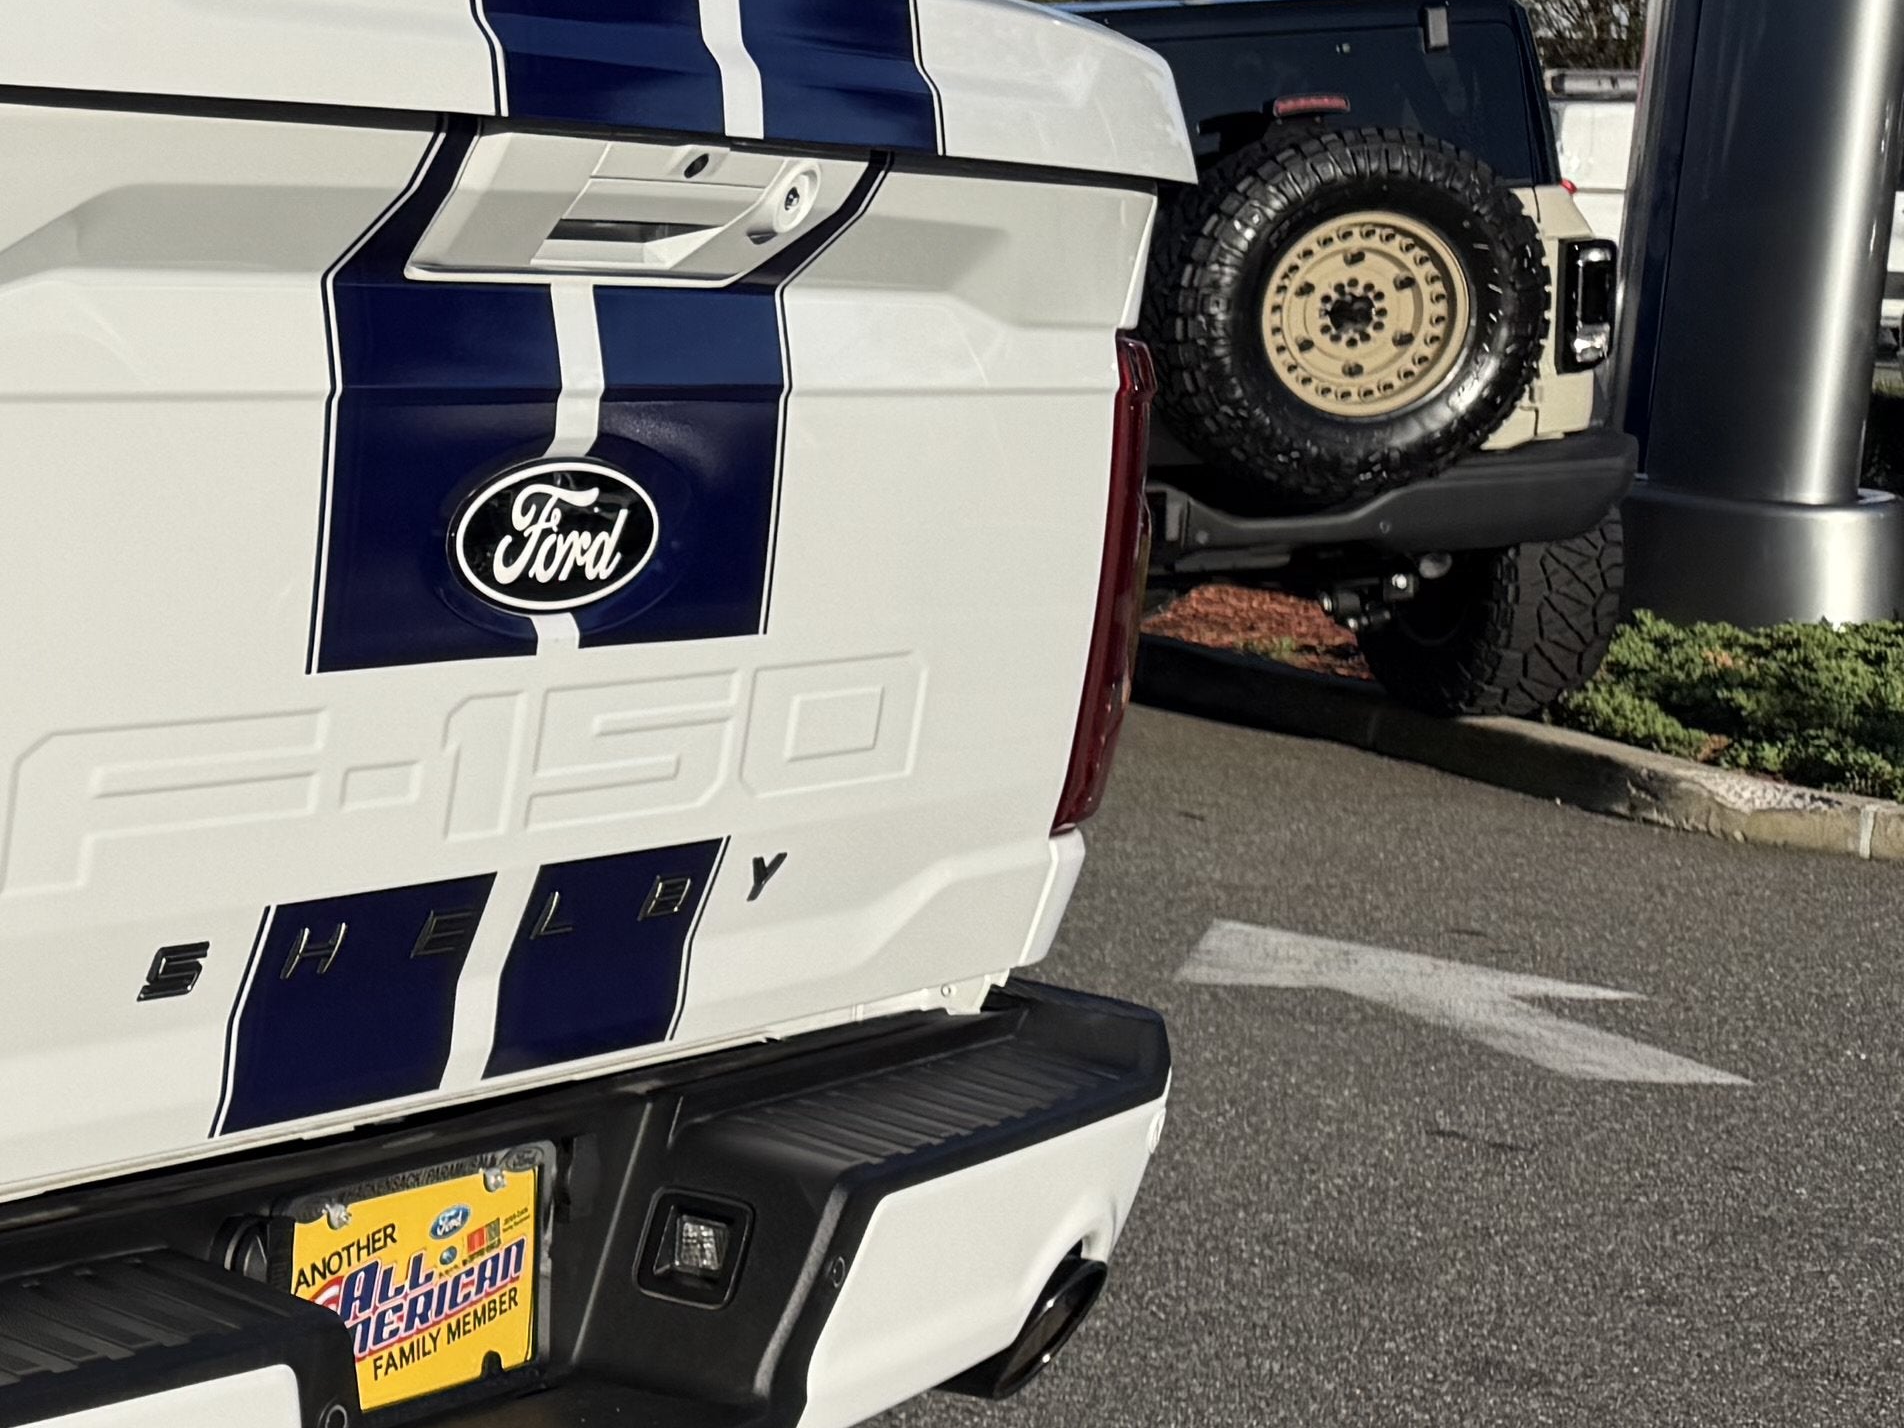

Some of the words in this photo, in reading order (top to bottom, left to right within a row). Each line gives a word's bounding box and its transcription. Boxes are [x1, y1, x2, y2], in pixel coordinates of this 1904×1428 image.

[492, 483, 629, 585] Ford
[0, 650, 931, 896] F-150
[136, 851, 789, 1003] SHELBY
[294, 1223, 398, 1294] ANOTHER
[435, 1207, 463, 1237] Ford
[373, 1327, 441, 1381] FAMILY
[446, 1286, 519, 1345] MEMBER
